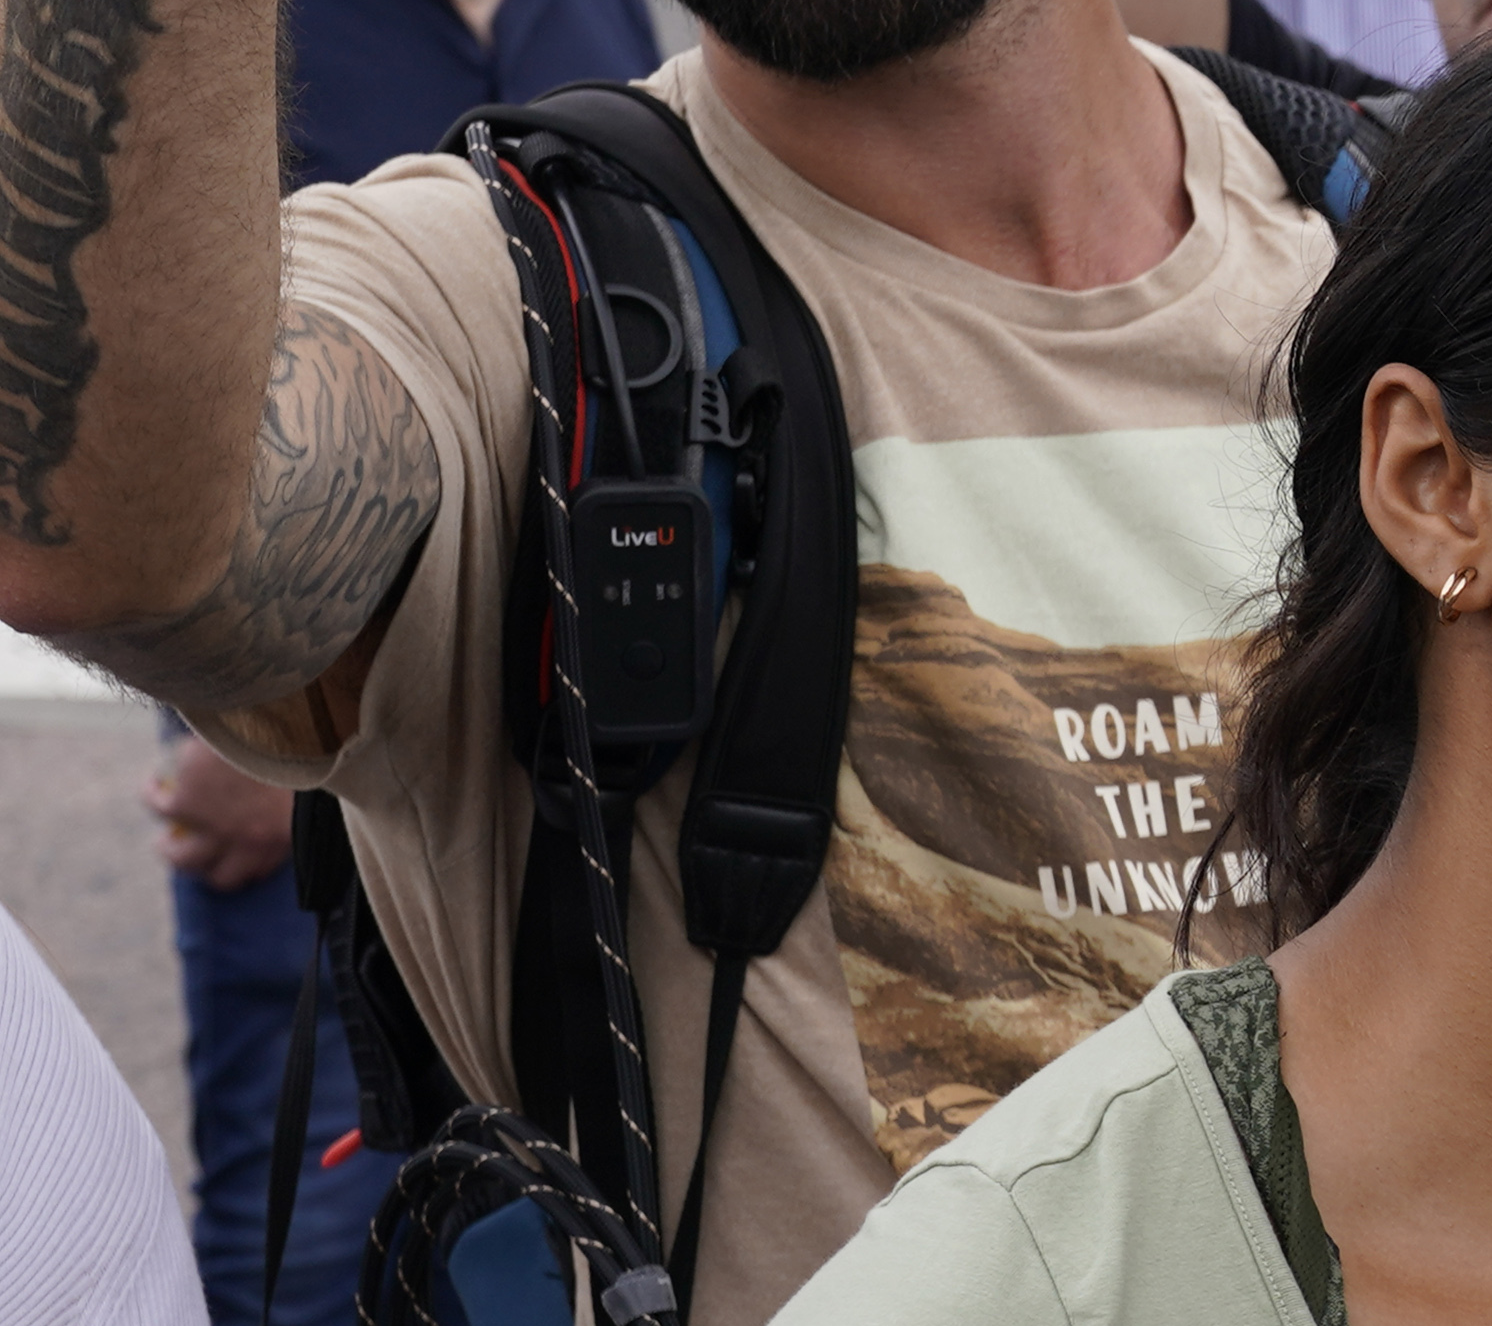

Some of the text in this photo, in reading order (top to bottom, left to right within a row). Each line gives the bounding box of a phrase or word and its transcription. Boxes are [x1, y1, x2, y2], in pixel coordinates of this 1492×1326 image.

[610, 525, 675, 547] LiveU
[1053, 692, 1224, 762] ROAM
[1095, 774, 1212, 839] THE
[1038, 848, 1271, 920] UNKNOW
